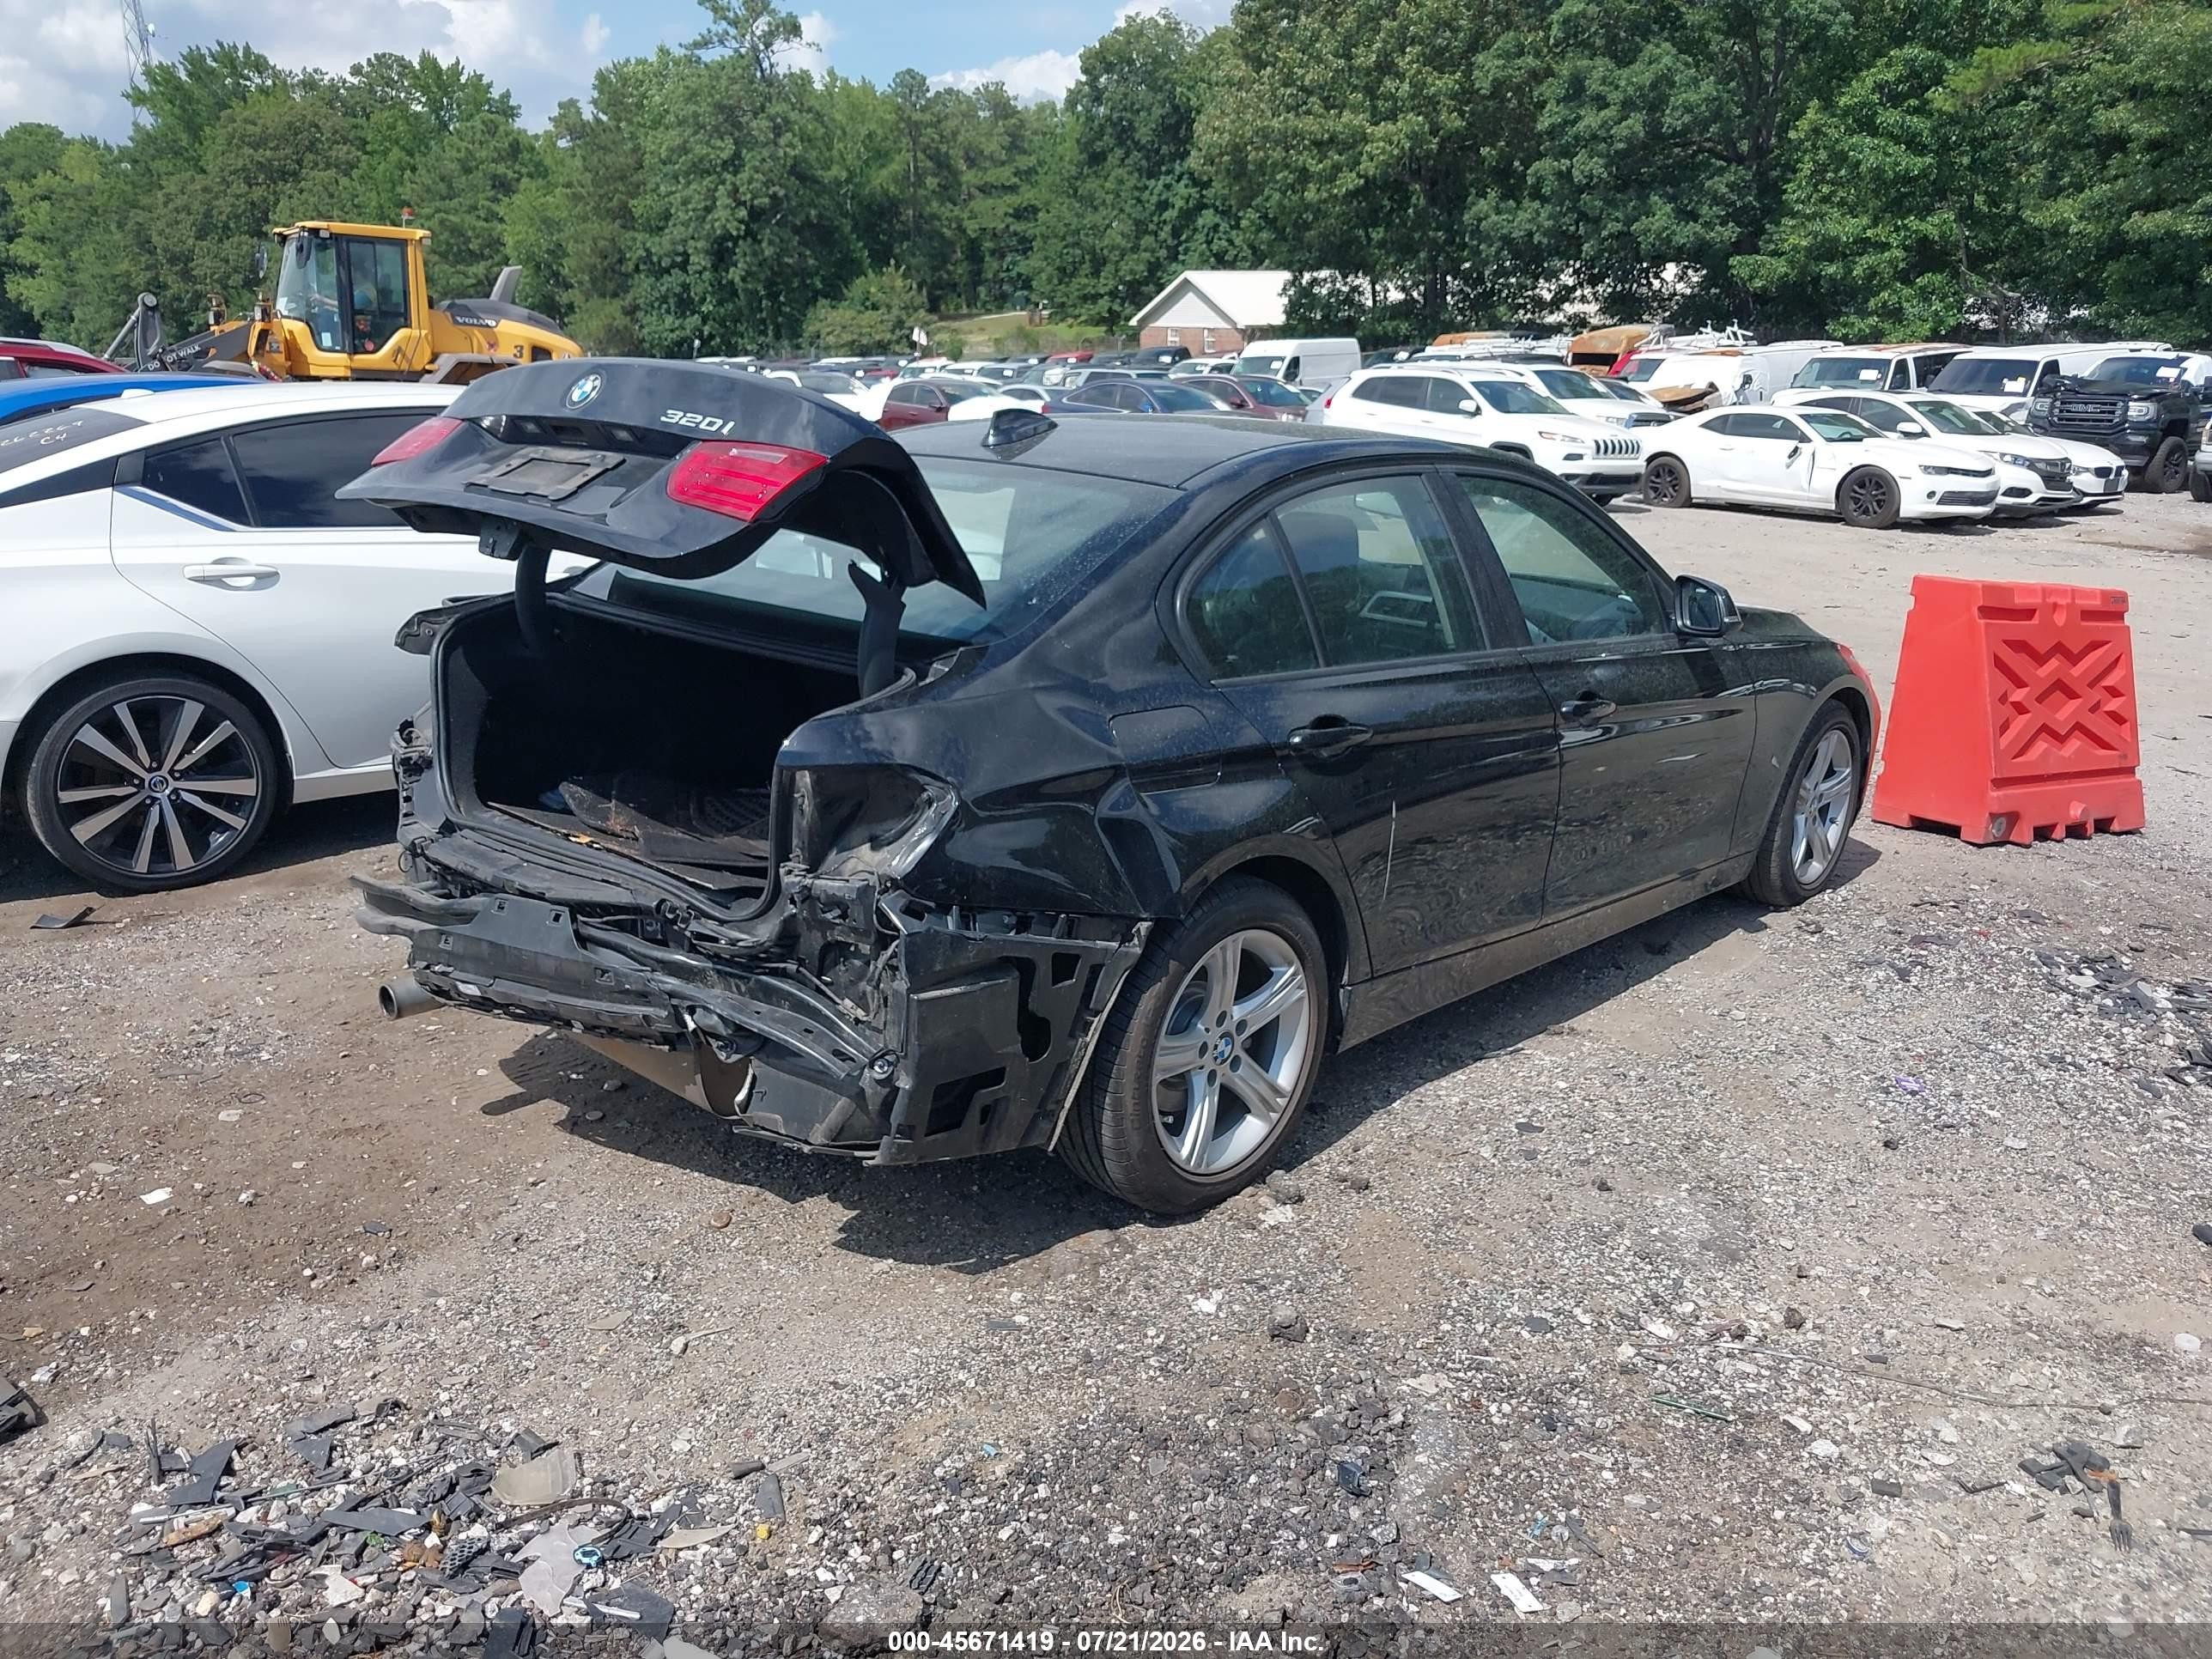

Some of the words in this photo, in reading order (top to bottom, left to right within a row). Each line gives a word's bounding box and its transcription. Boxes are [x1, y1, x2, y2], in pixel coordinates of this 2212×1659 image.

[454, 316, 496, 326] VOLVO
[513, 344, 524, 358] 3
[148, 361, 161, 371] DO
[166, 352, 178, 362] OT
[179, 344, 202, 357] WALK
[2071, 404, 2101, 412] GMC
